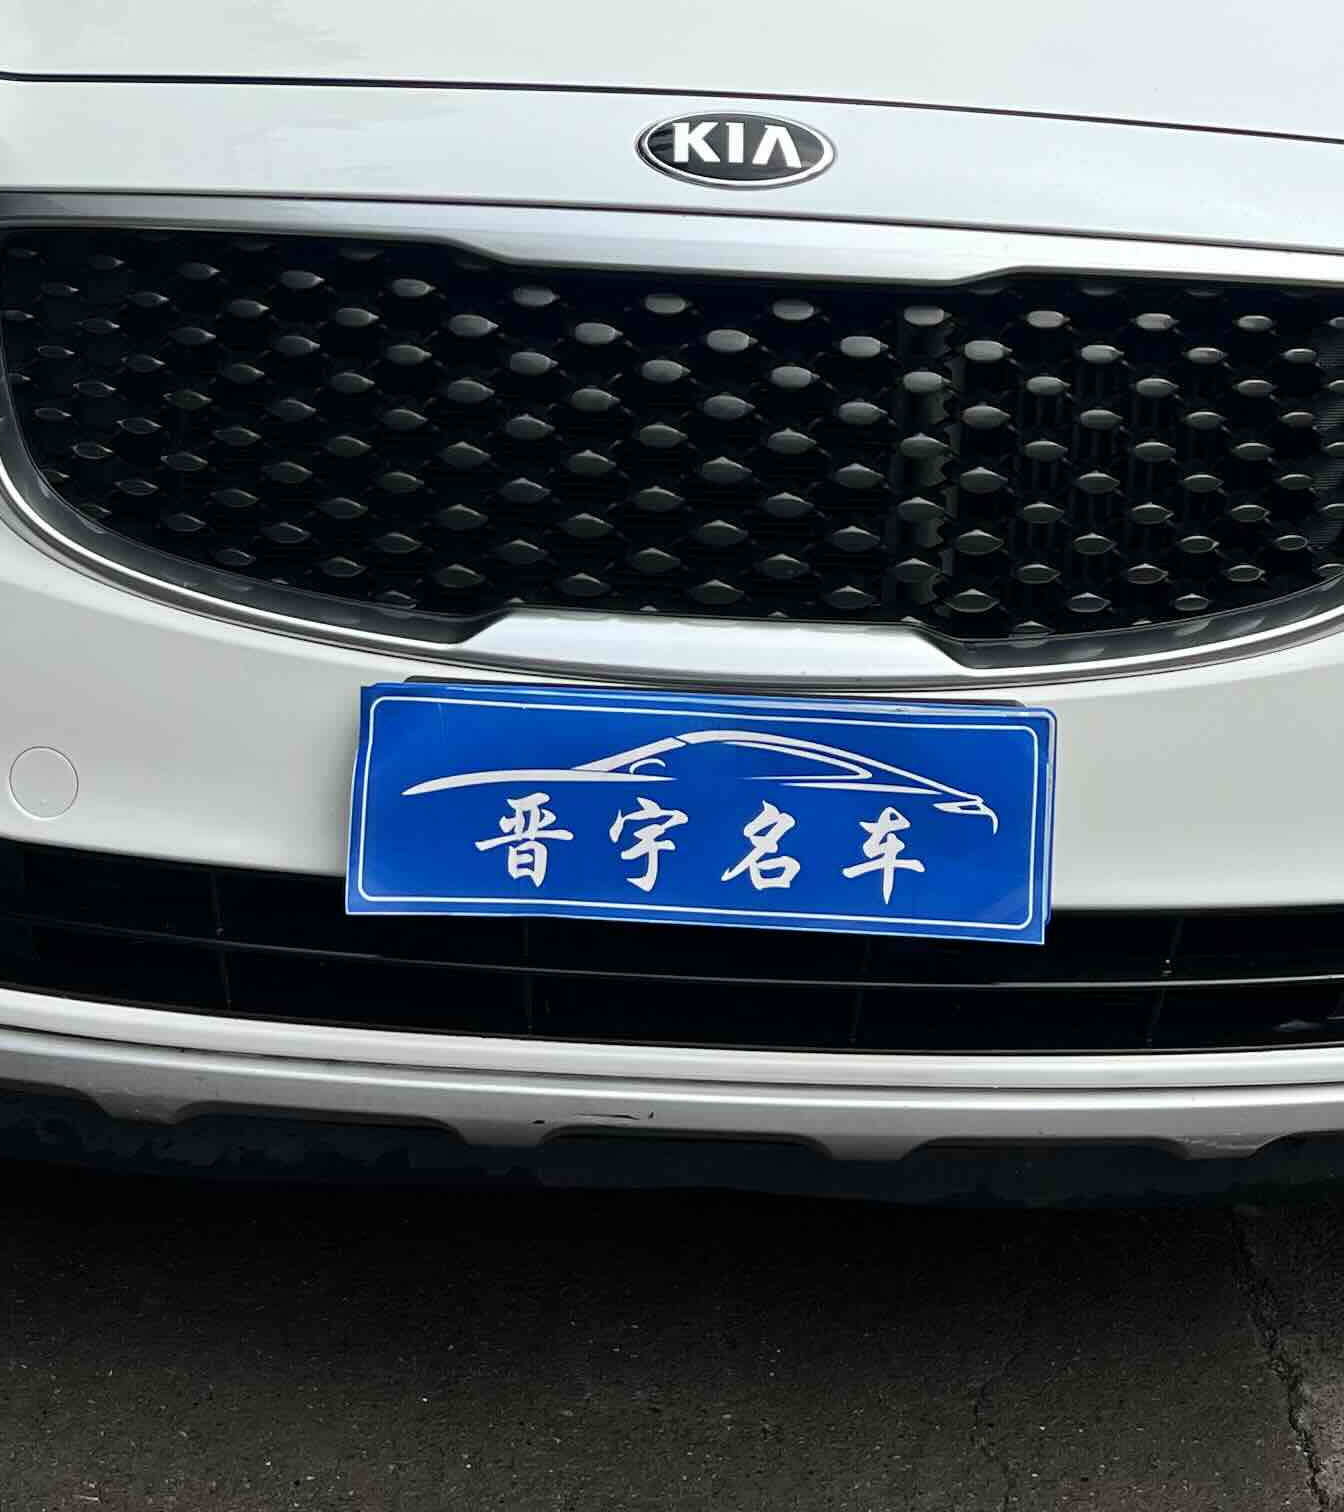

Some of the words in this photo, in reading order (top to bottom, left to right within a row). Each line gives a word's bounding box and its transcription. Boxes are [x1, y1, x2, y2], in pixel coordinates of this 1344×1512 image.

[671, 120, 802, 169] KIA
[474, 791, 926, 906] 晋宇名车
